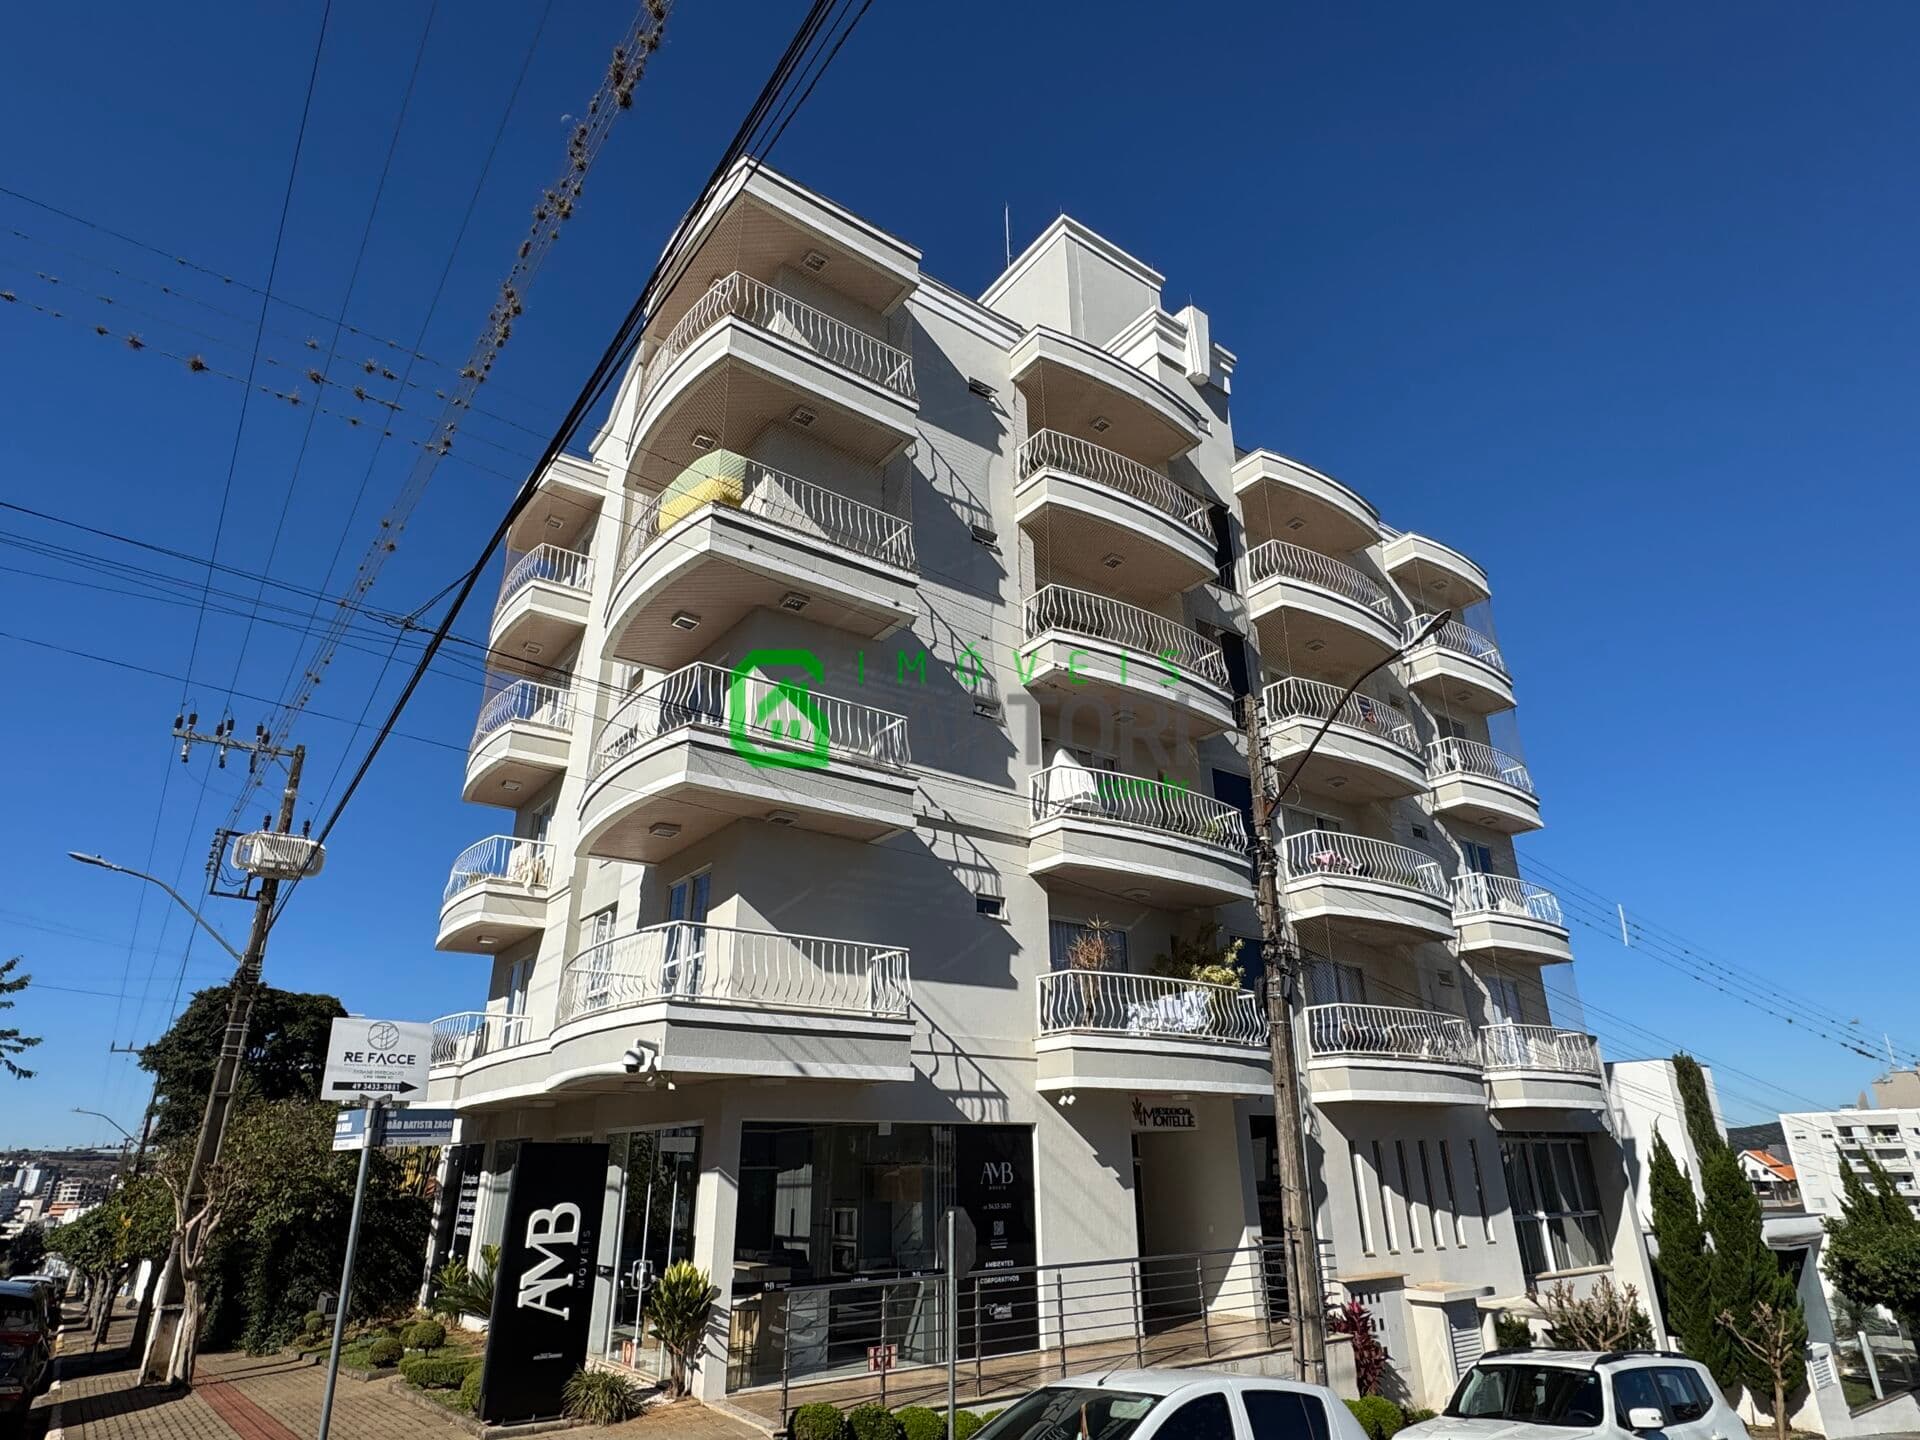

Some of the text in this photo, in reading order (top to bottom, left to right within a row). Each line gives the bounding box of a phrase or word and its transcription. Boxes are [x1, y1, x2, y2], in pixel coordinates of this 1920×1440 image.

[343, 1051, 417, 1065] RE FACCE
[403, 1120, 433, 1130] BATISTA
[433, 1119, 453, 1129] ZAGO
[980, 1161, 1014, 1185] AMB
[517, 1202, 581, 1321] AMB
[576, 1230, 591, 1289] MÓVEIS
